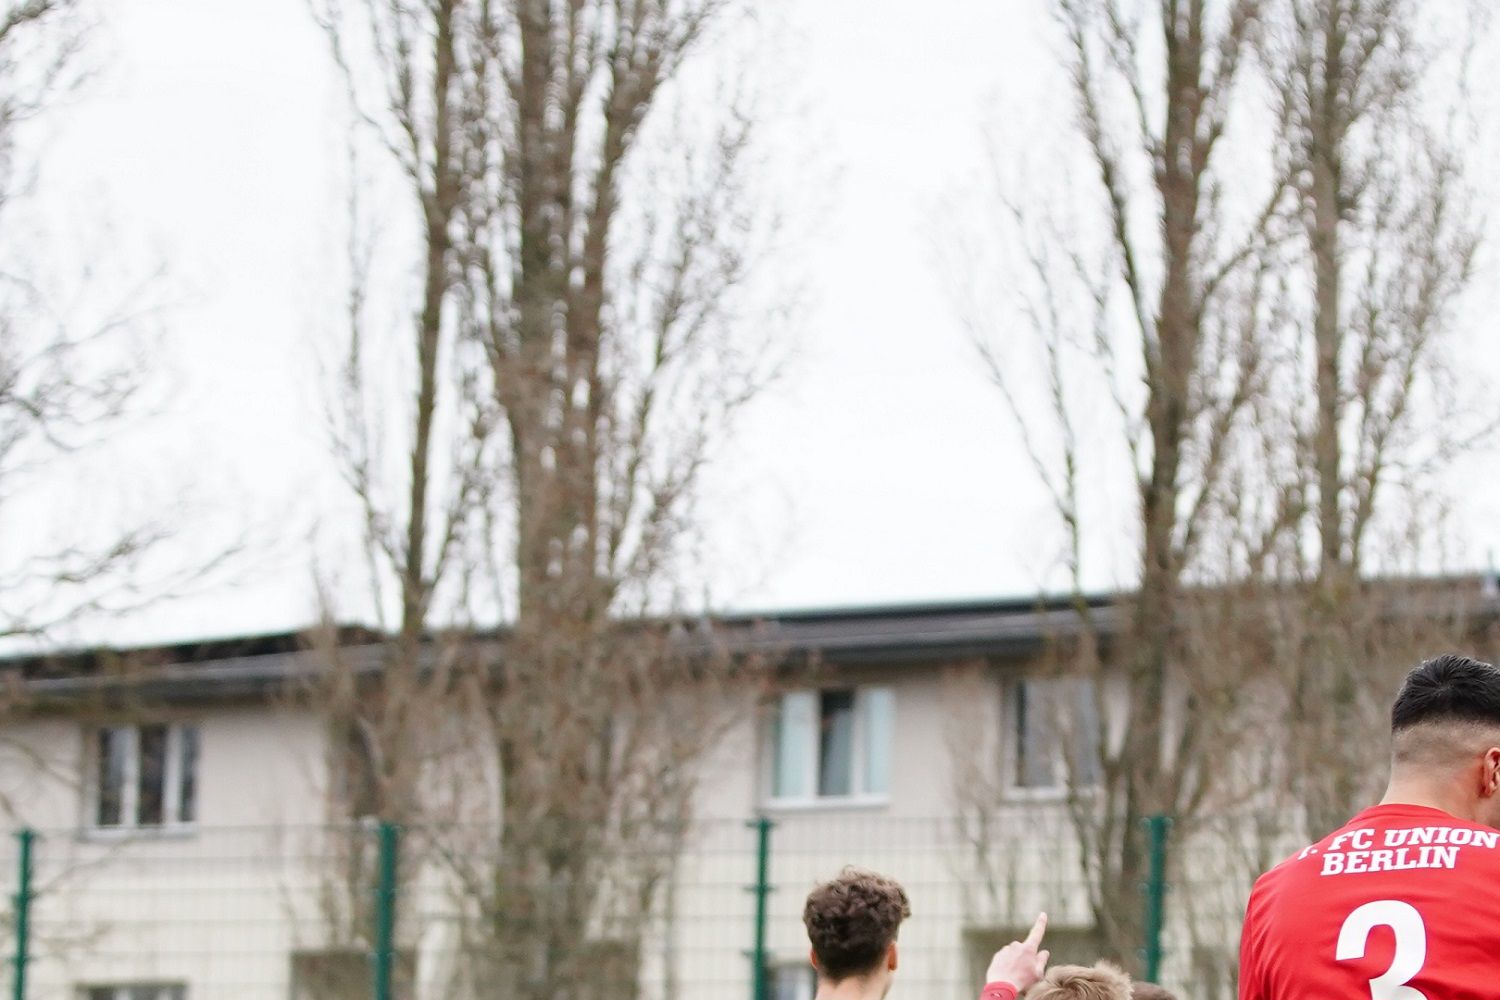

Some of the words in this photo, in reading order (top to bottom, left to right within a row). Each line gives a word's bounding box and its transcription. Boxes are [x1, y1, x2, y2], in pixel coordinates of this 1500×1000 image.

[1327, 828, 1376, 851] FC
[1384, 826, 1500, 849] UNION
[1319, 846, 1461, 876] BERLIN
